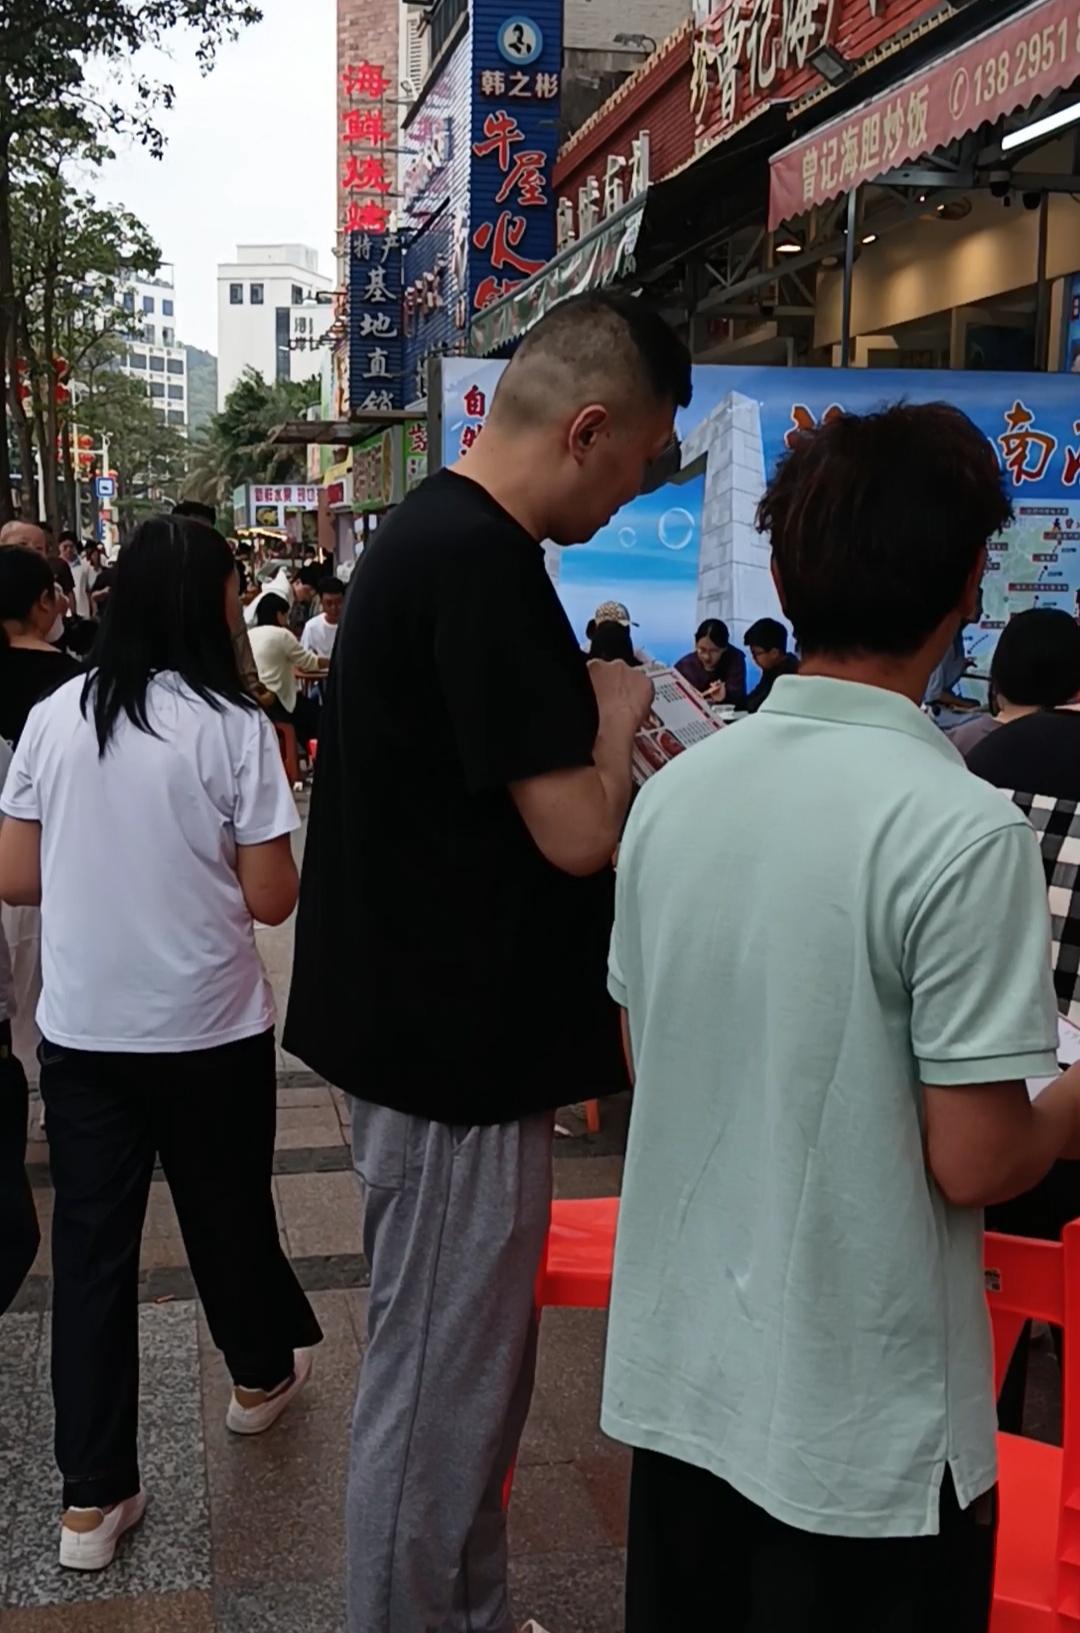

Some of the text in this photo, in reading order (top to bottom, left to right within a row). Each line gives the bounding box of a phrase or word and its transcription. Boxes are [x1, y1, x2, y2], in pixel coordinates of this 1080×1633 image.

[481, 70, 558, 99] 韩之彬
[973, 50, 1010, 106] 138
[1013, 16, 1068, 87] 2951
[341, 60, 391, 234] 海鲜烧烤
[801, 83, 931, 202] 曾记海胆炒饭
[353, 232, 400, 263] 特产
